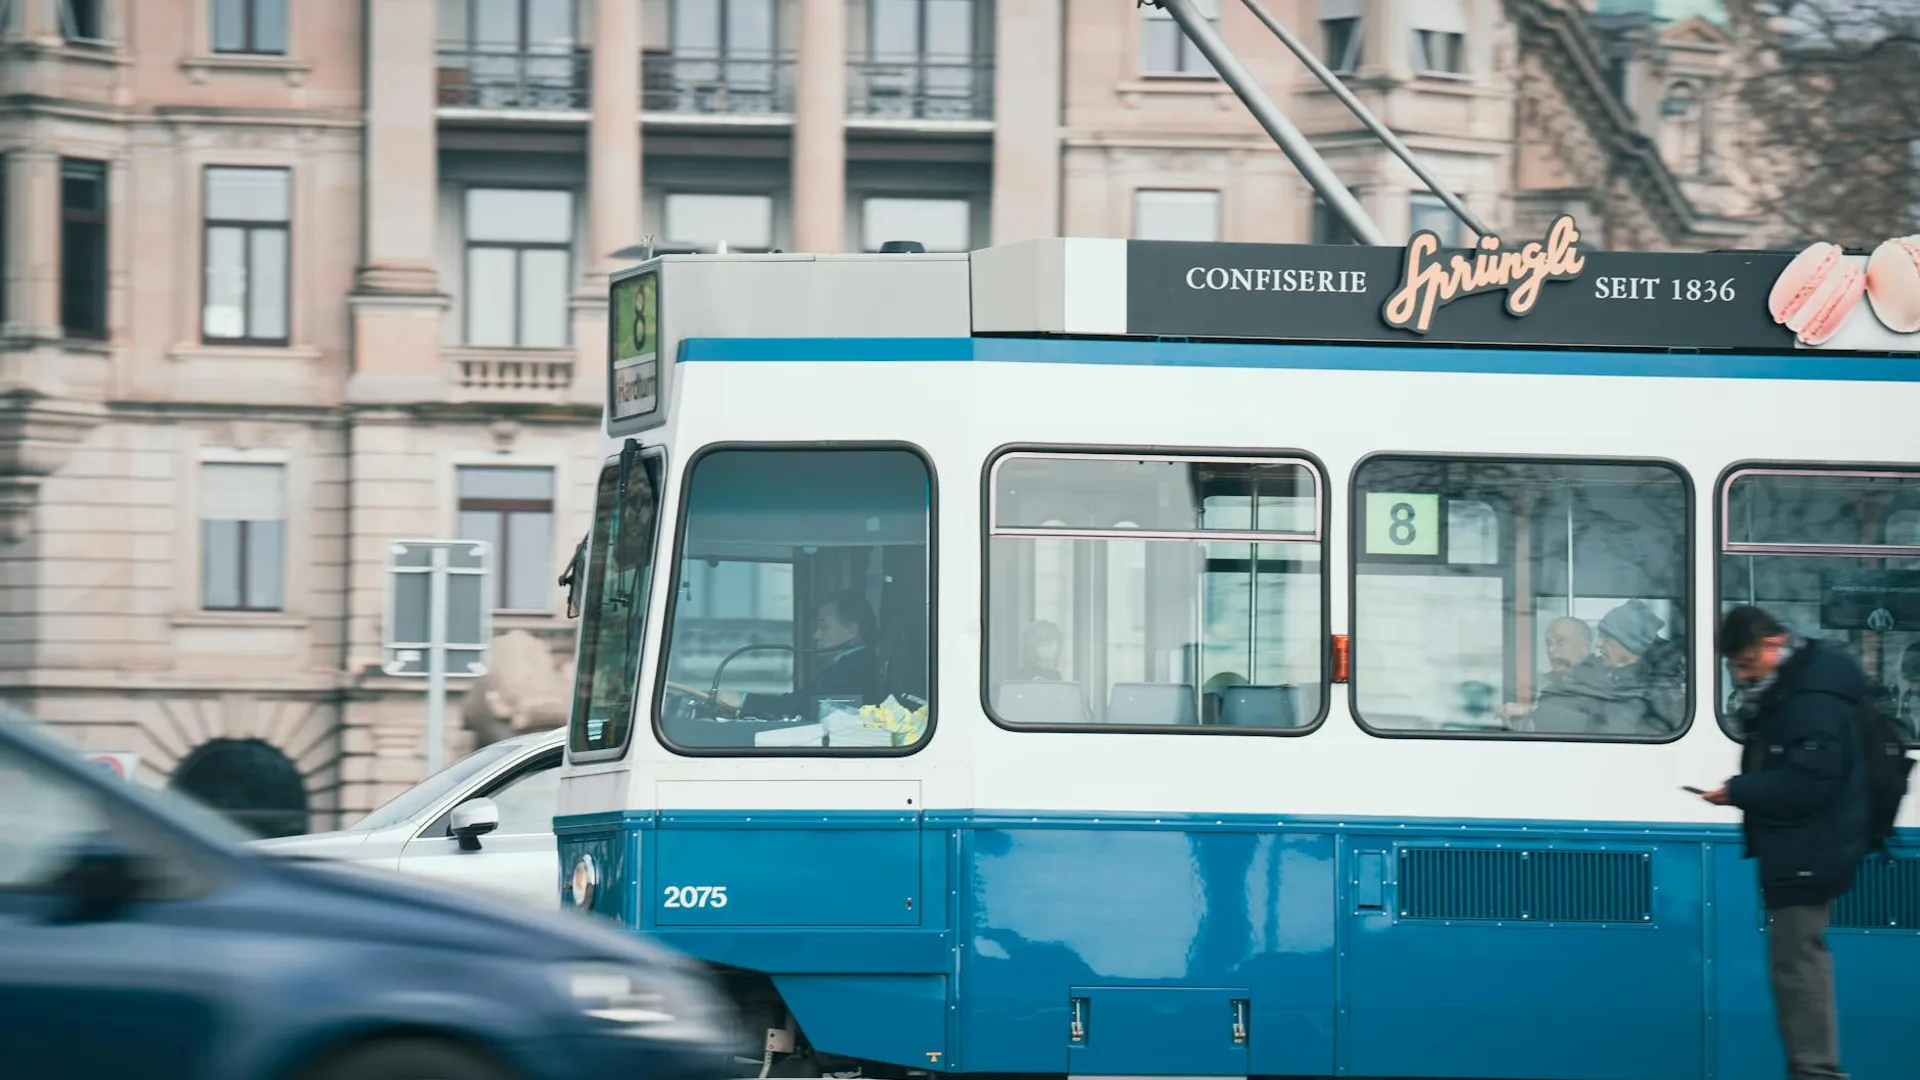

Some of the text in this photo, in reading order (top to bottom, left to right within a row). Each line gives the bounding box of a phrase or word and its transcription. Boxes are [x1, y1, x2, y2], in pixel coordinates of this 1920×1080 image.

[1185, 215, 1736, 331] CONFISERIE Sprüngli SEIT 1836
[634, 284, 646, 351] 8
[1388, 501, 1417, 546] 8
[663, 885, 728, 908] 2075
